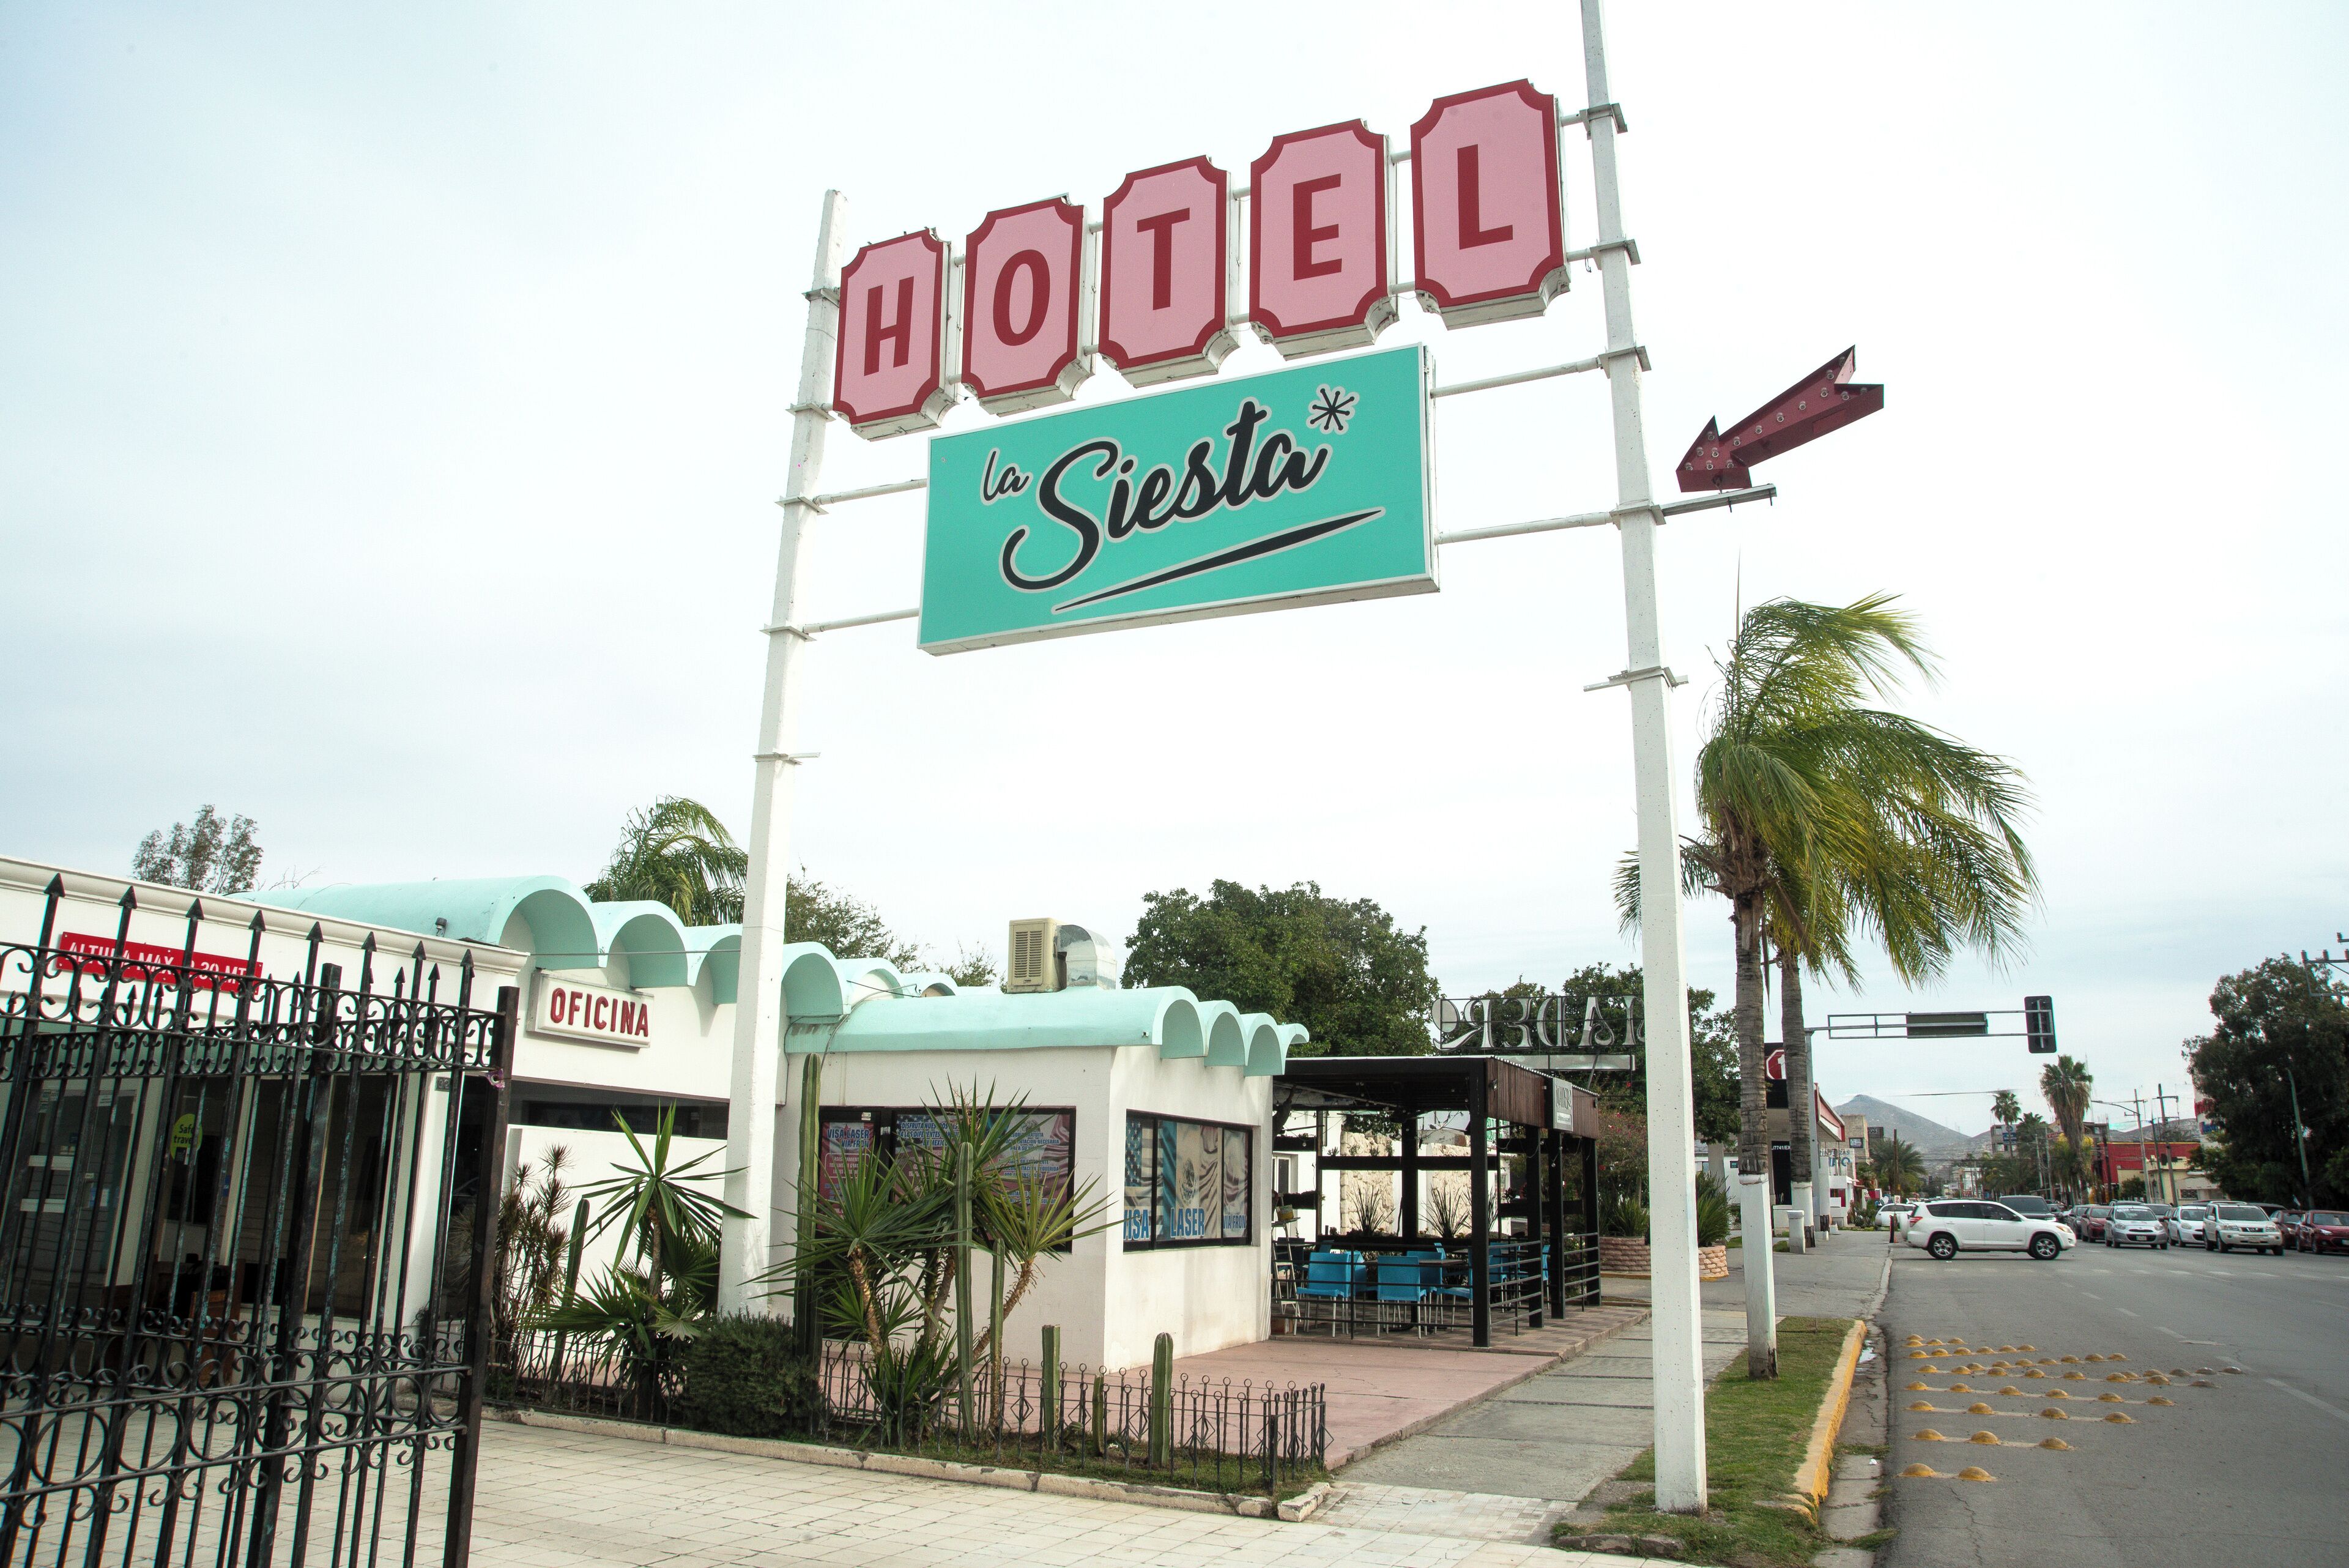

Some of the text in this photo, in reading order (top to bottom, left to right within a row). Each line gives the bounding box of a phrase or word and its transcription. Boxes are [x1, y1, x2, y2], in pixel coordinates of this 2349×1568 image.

[864, 144, 1513, 376] HOTEL
[983, 450, 1030, 501] la
[1001, 400, 1329, 590] Siesta
[224, 965, 247, 984] MT
[551, 987, 648, 1037] OFICINA
[174, 1135, 191, 1144] trave
[827, 1129, 869, 1139] VISA LASER
[1171, 1208, 1204, 1237] LASER
[1233, 1214, 1246, 1229] FRON
